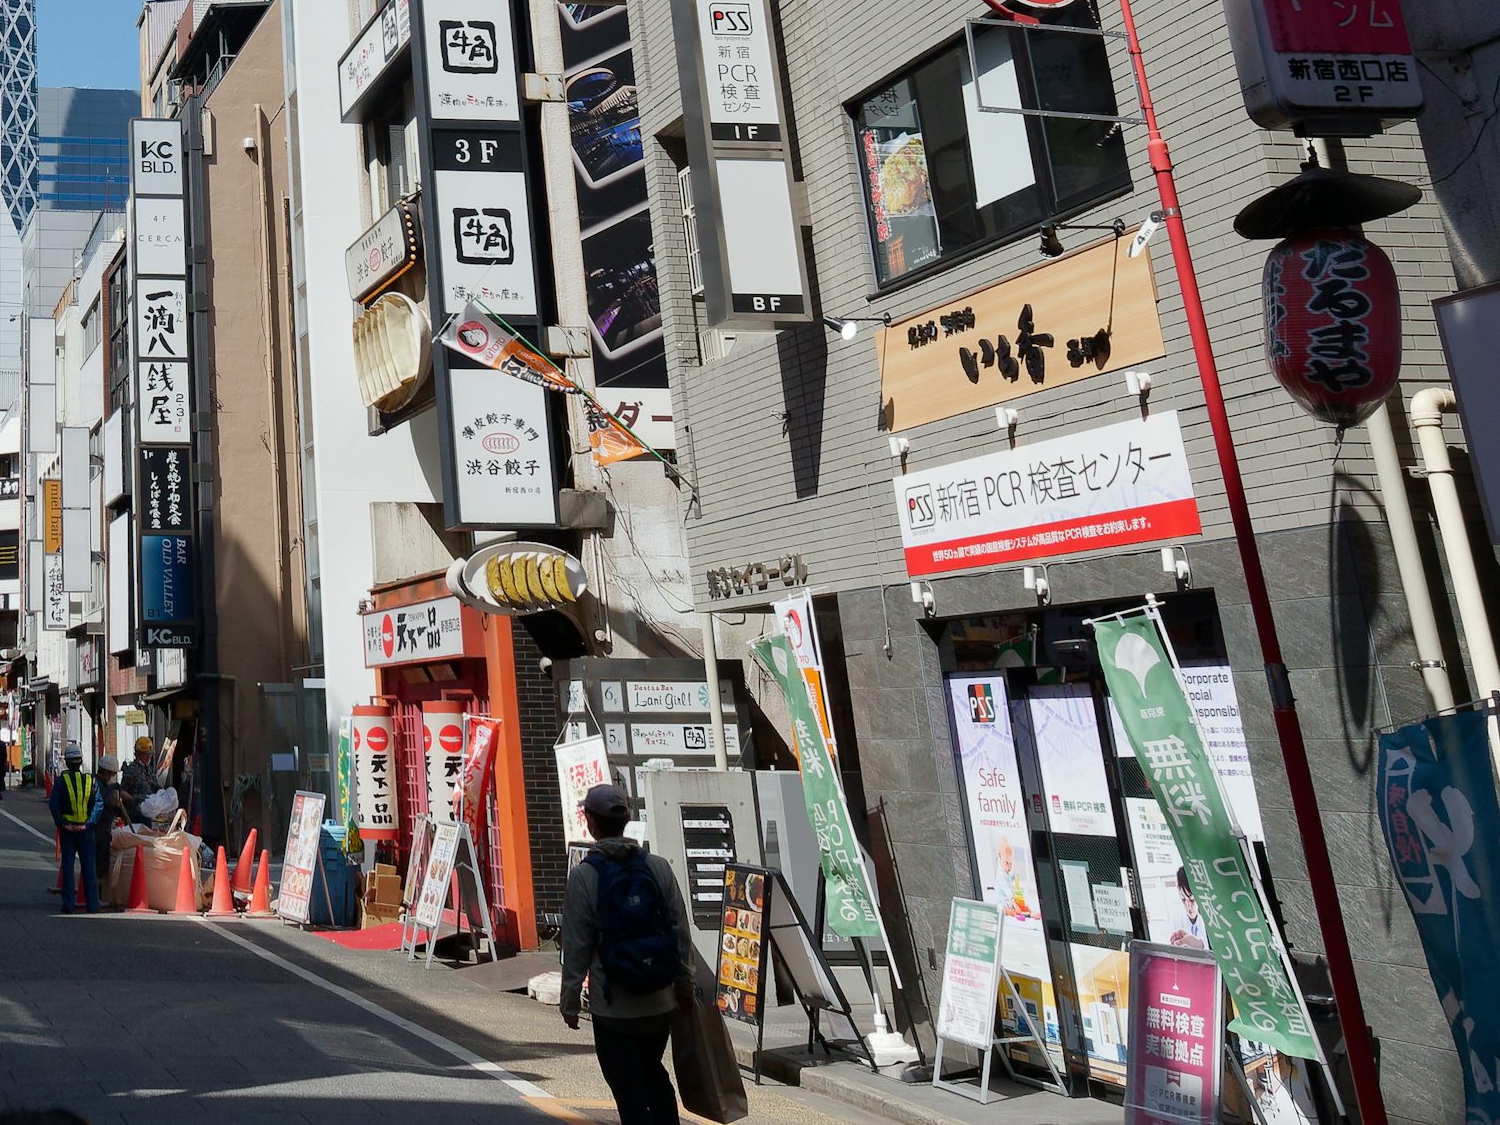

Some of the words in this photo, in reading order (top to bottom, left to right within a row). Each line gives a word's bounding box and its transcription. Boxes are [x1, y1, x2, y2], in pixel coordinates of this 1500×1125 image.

[712, 10, 750, 33] PSS
[447, 30, 493, 62] 牛角
[718, 45, 750, 58] 新宿
[717, 64, 757, 83] PCR
[1288, 58, 1409, 82] 新宿西口店
[721, 83, 760, 100] 検査
[1334, 86, 1375, 102] 2F
[721, 101, 761, 113] センター
[734, 126, 757, 140] 1F
[454, 139, 498, 164] 3F
[141, 161, 177, 174] BLD.
[462, 219, 509, 252] 牛角
[1135, 228, 1153, 247] 4m
[752, 297, 781, 311] BF
[1302, 240, 1372, 394] だるまや
[143, 450, 154, 460] 1F
[466, 459, 540, 476] 渋谷餃子
[936, 478, 980, 522] 新宿
[985, 470, 1025, 510] PCR
[1027, 442, 1172, 505] 検査センター
[51, 484, 62, 510] miel
[51, 516, 62, 543] hair
[162, 538, 172, 566] OLD
[176, 538, 186, 564] BAR
[164, 567, 175, 617] VALLEY
[148, 629, 172, 644] KC
[173, 636, 193, 644] BLD.
[397, 606, 441, 653] 天下一品
[635, 692, 662, 707] Lani
[665, 693, 692, 709] Girl!
[1189, 689, 1212, 701] ocial
[969, 696, 994, 722] PSS
[687, 730, 704, 744] 牛角
[371, 755, 393, 824] 天下一品
[979, 768, 1006, 788] Safe
[977, 793, 1017, 817] family
[1063, 801, 1076, 812] 無料
[1077, 802, 1093, 812] PCR
[1093, 802, 1107, 813] 検査
[1146, 1006, 1205, 1038] 無料検査
[1146, 1034, 1204, 1067] 実施拠点
